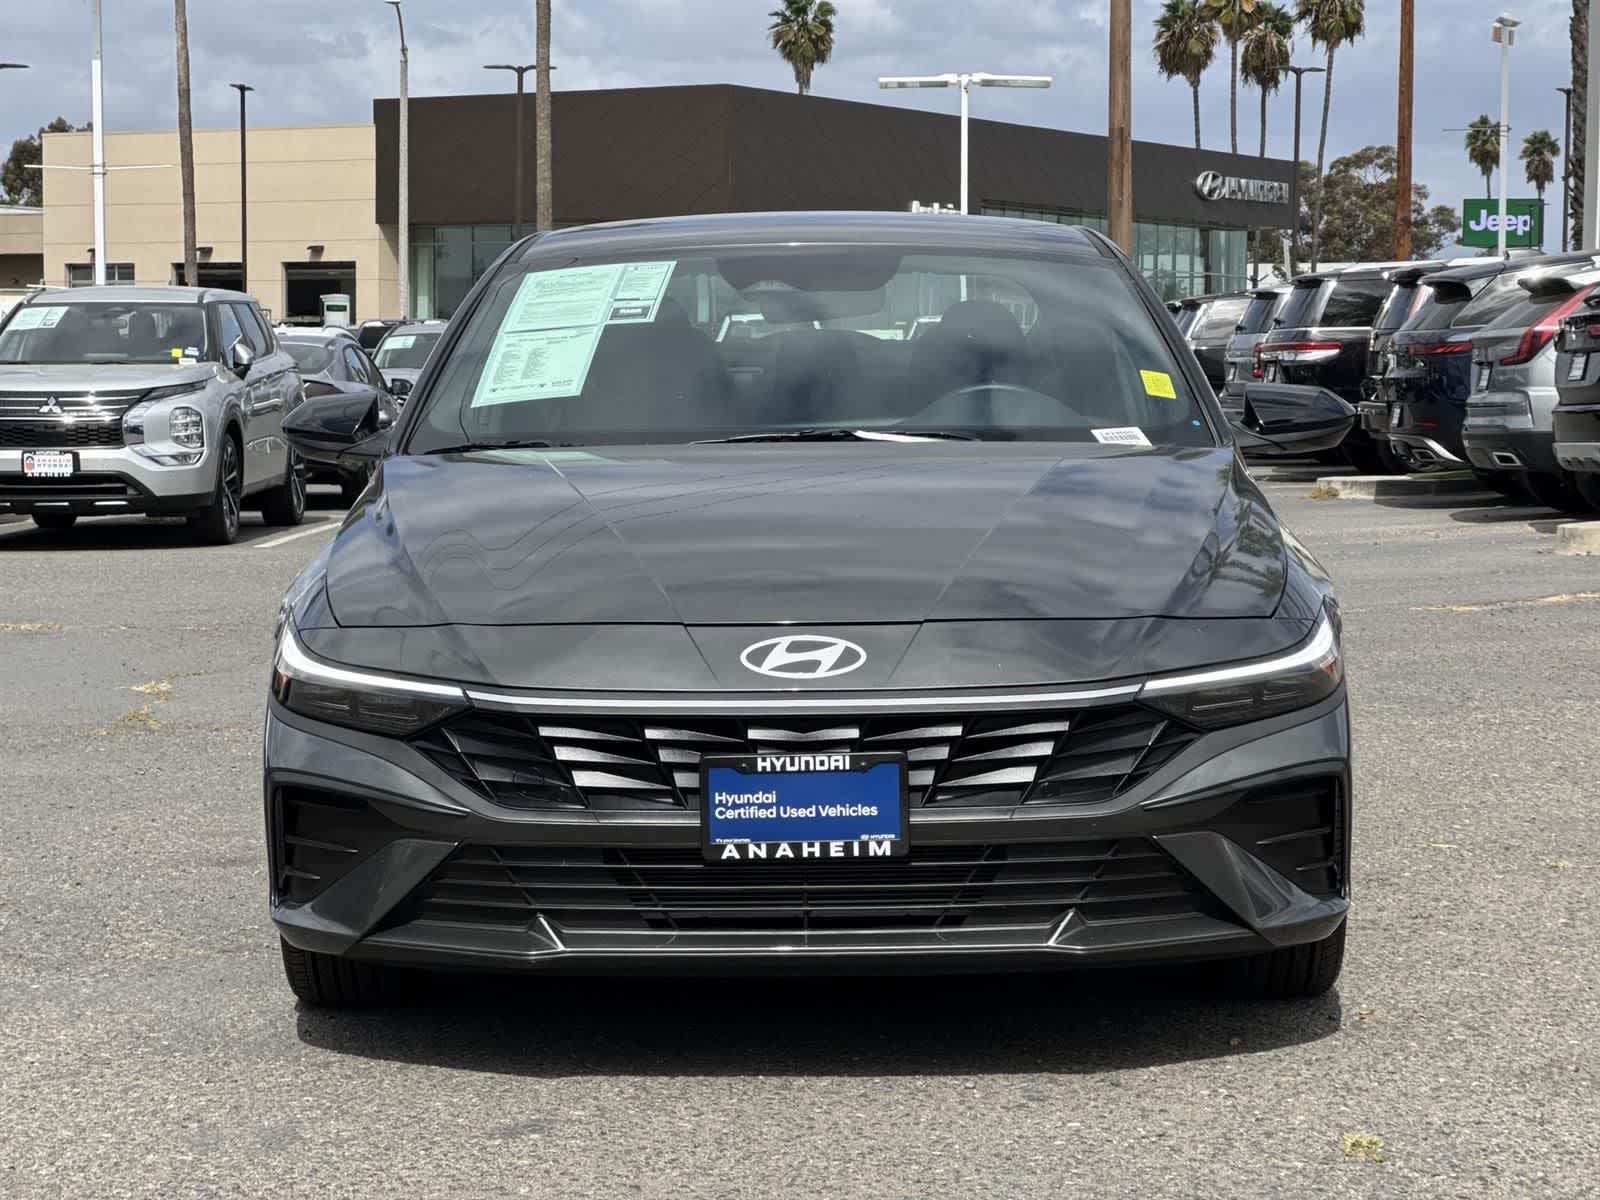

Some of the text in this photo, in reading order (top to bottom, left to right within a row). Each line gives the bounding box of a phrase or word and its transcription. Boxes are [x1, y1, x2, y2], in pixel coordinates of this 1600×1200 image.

[1469, 209, 1534, 236] Jeep
[757, 755, 850, 772] HYUNDAI
[714, 791, 777, 807] Hyundai
[714, 803, 879, 820] Certified Used Vehicles
[721, 841, 892, 860] ANAHEIM
